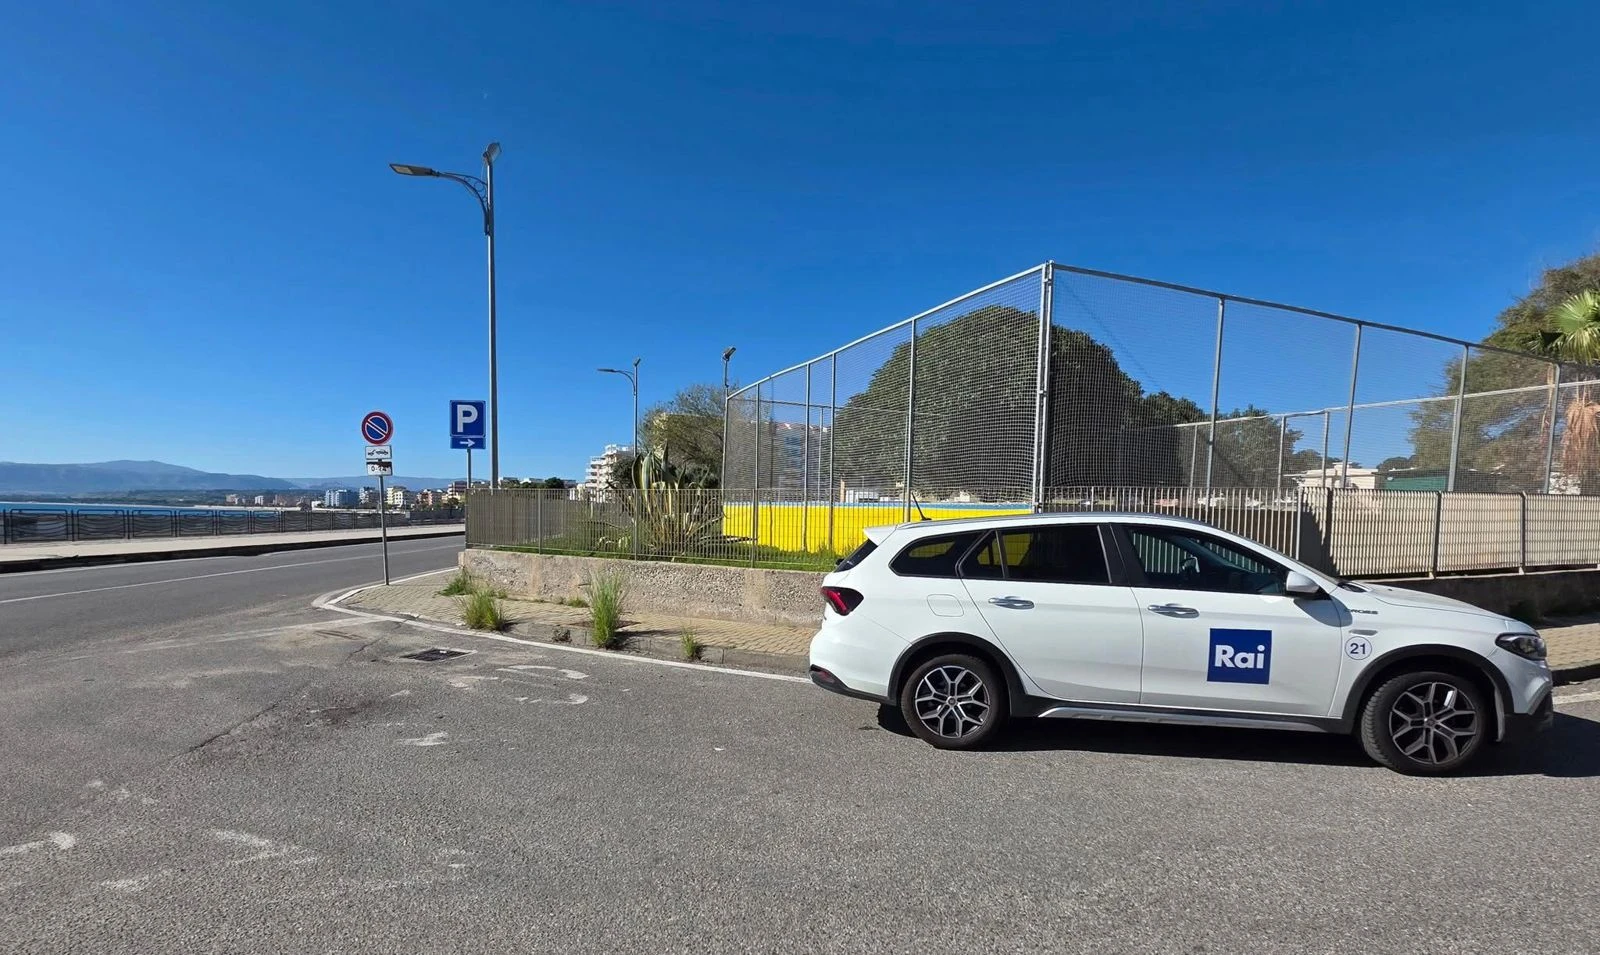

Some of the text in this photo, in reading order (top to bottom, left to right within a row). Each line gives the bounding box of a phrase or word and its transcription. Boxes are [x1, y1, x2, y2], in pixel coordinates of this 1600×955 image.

[456, 404, 478, 433] P
[1214, 644, 1266, 669] Rai
[1350, 643, 1366, 655] 21
